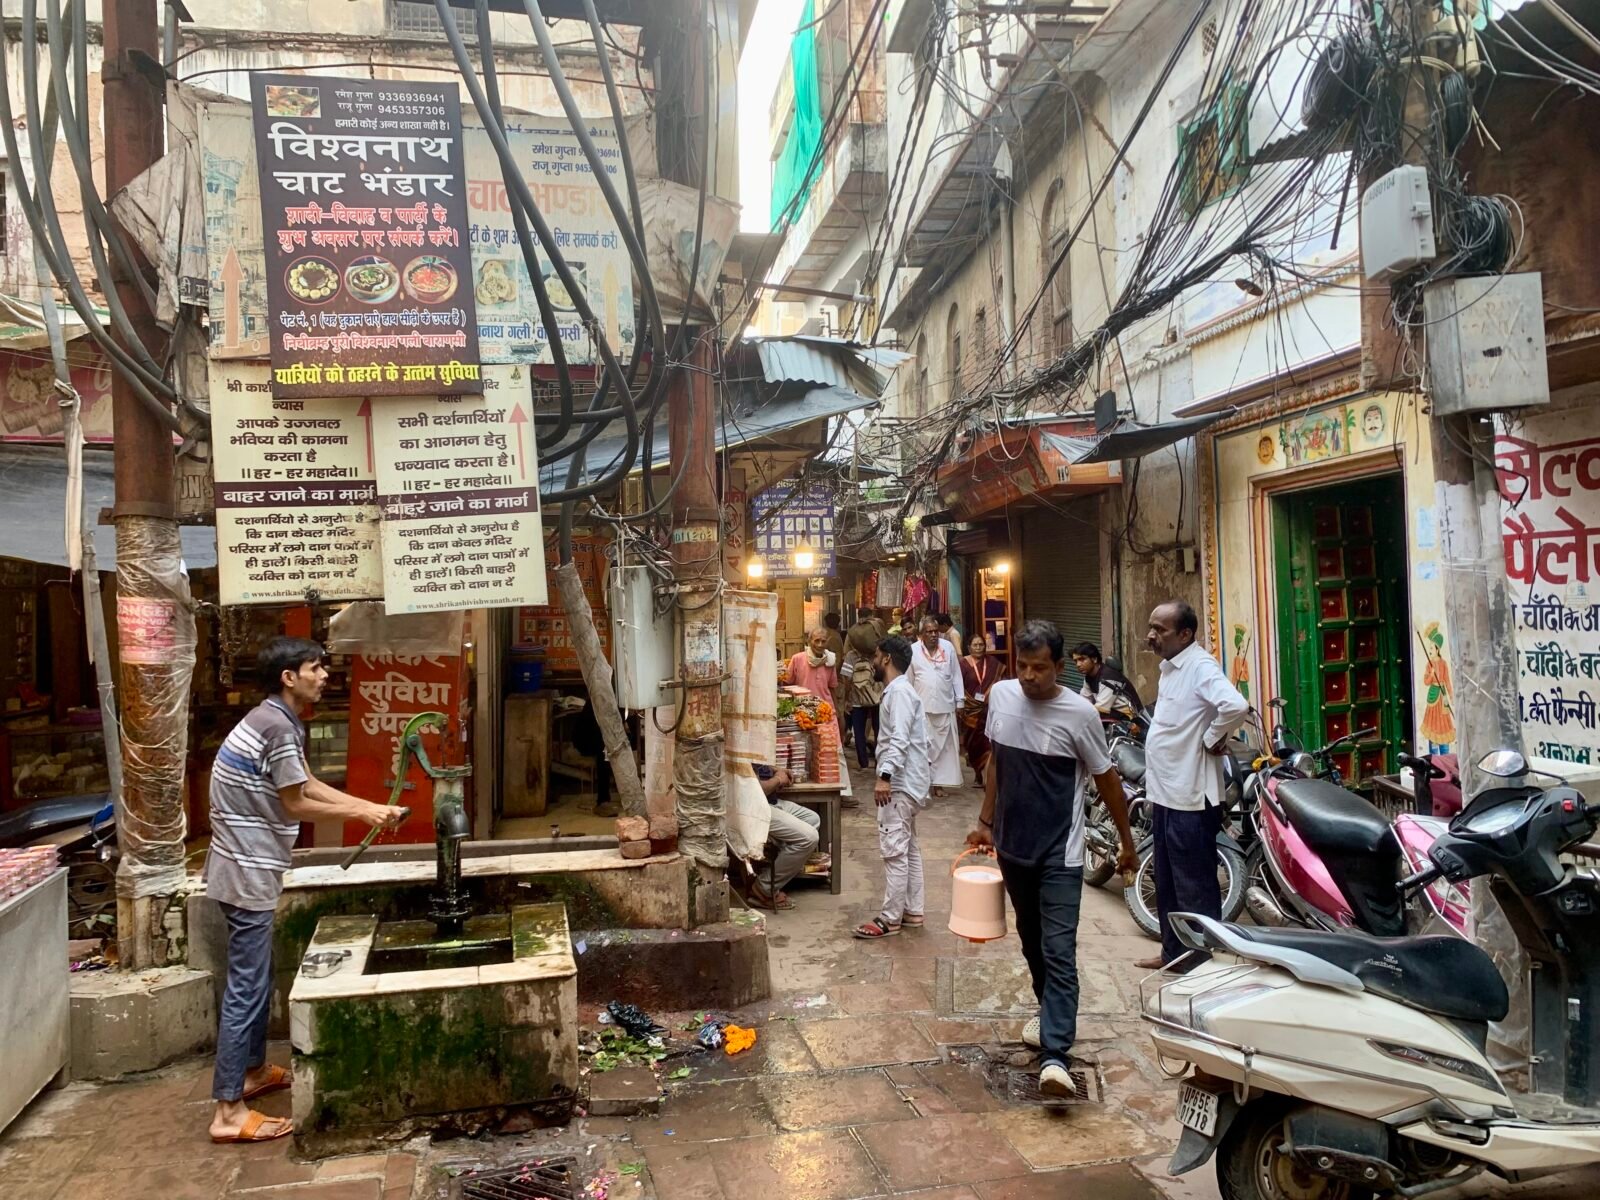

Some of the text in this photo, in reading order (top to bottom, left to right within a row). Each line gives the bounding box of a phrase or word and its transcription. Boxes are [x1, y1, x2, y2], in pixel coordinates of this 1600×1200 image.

[378, 92, 444, 103] 9336936941
[377, 105, 445, 116] 9453357306
[267, 122, 454, 163] विश्वनाथ
[532, 142, 576, 160] रमेश गुप्ता
[532, 160, 552, 176] राजू
[552, 162, 573, 176] गुप्ता
[272, 166, 454, 197] चाट भंडार
[378, 207, 392, 224] व
[394, 202, 428, 224] पार्टी
[432, 203, 448, 224] के
[277, 230, 307, 254] शुभ
[312, 230, 359, 248] अवसर
[361, 230, 385, 247] पर
[387, 224, 425, 248] संपर्क
[482, 225, 490, 243] के
[493, 228, 509, 248] शुभ
[554, 227, 571, 247] लिए
[338, 313, 363, 330] दुकान
[420, 309, 430, 326] के
[432, 312, 451, 326] उपर
[350, 331, 398, 349] विश्वनाथ
[399, 330, 422, 348] गली
[422, 329, 466, 349] वाराणसी
[508, 321, 530, 340] गली
[324, 362, 344, 383] को
[346, 362, 382, 383] ठहरने
[384, 362, 400, 382] के
[272, 400, 304, 411] न्यास
[236, 416, 341, 429] आपके उज्जवल
[398, 408, 506, 428] सभी दर्शनार्थियों
[230, 431, 348, 446] भविष्य की कामना
[400, 431, 508, 450] का आगमन हेतु
[264, 448, 318, 462] करता है
[394, 458, 450, 472] धन्यवाद
[454, 456, 494, 469] करता
[286, 468, 303, 479] हर
[444, 478, 460, 490] हर
[223, 484, 375, 504] बाहर जाने का मार्ग
[429, 496, 464, 512] जाने
[468, 498, 490, 510] का
[495, 492, 529, 508] मार्ग
[298, 513, 308, 524] से
[246, 528, 262, 540] कि
[266, 530, 288, 539] दान
[292, 528, 323, 538] केवल
[456, 522, 468, 534] से
[470, 521, 508, 536] अनुरोध
[511, 520, 520, 532] है
[228, 542, 266, 554] परिसर
[269, 542, 282, 553] में
[284, 542, 306, 553] लगे
[308, 543, 330, 552] दान
[408, 540, 424, 552] कि
[427, 540, 448, 550] दान
[452, 538, 483, 548] केवल
[245, 556, 258, 568] ही
[294, 555, 324, 566] किसी
[394, 548, 530, 566] परिसर में लगे दान पात्रों में
[248, 570, 284, 582] व्यक्ति
[288, 570, 304, 580] को
[308, 570, 330, 580] दान
[333, 570, 344, 579] न
[409, 568, 421, 581] ही
[455, 564, 483, 576] किसी
[486, 562, 516, 574] बाहरी
[413, 576, 516, 594] व्यक्ति को दान न दें
[416, 596, 525, 610] www.shrikashivishwanath.org
[1564, 607, 1580, 632] के
[1565, 650, 1580, 678] के
[358, 671, 452, 713] सुविधा
